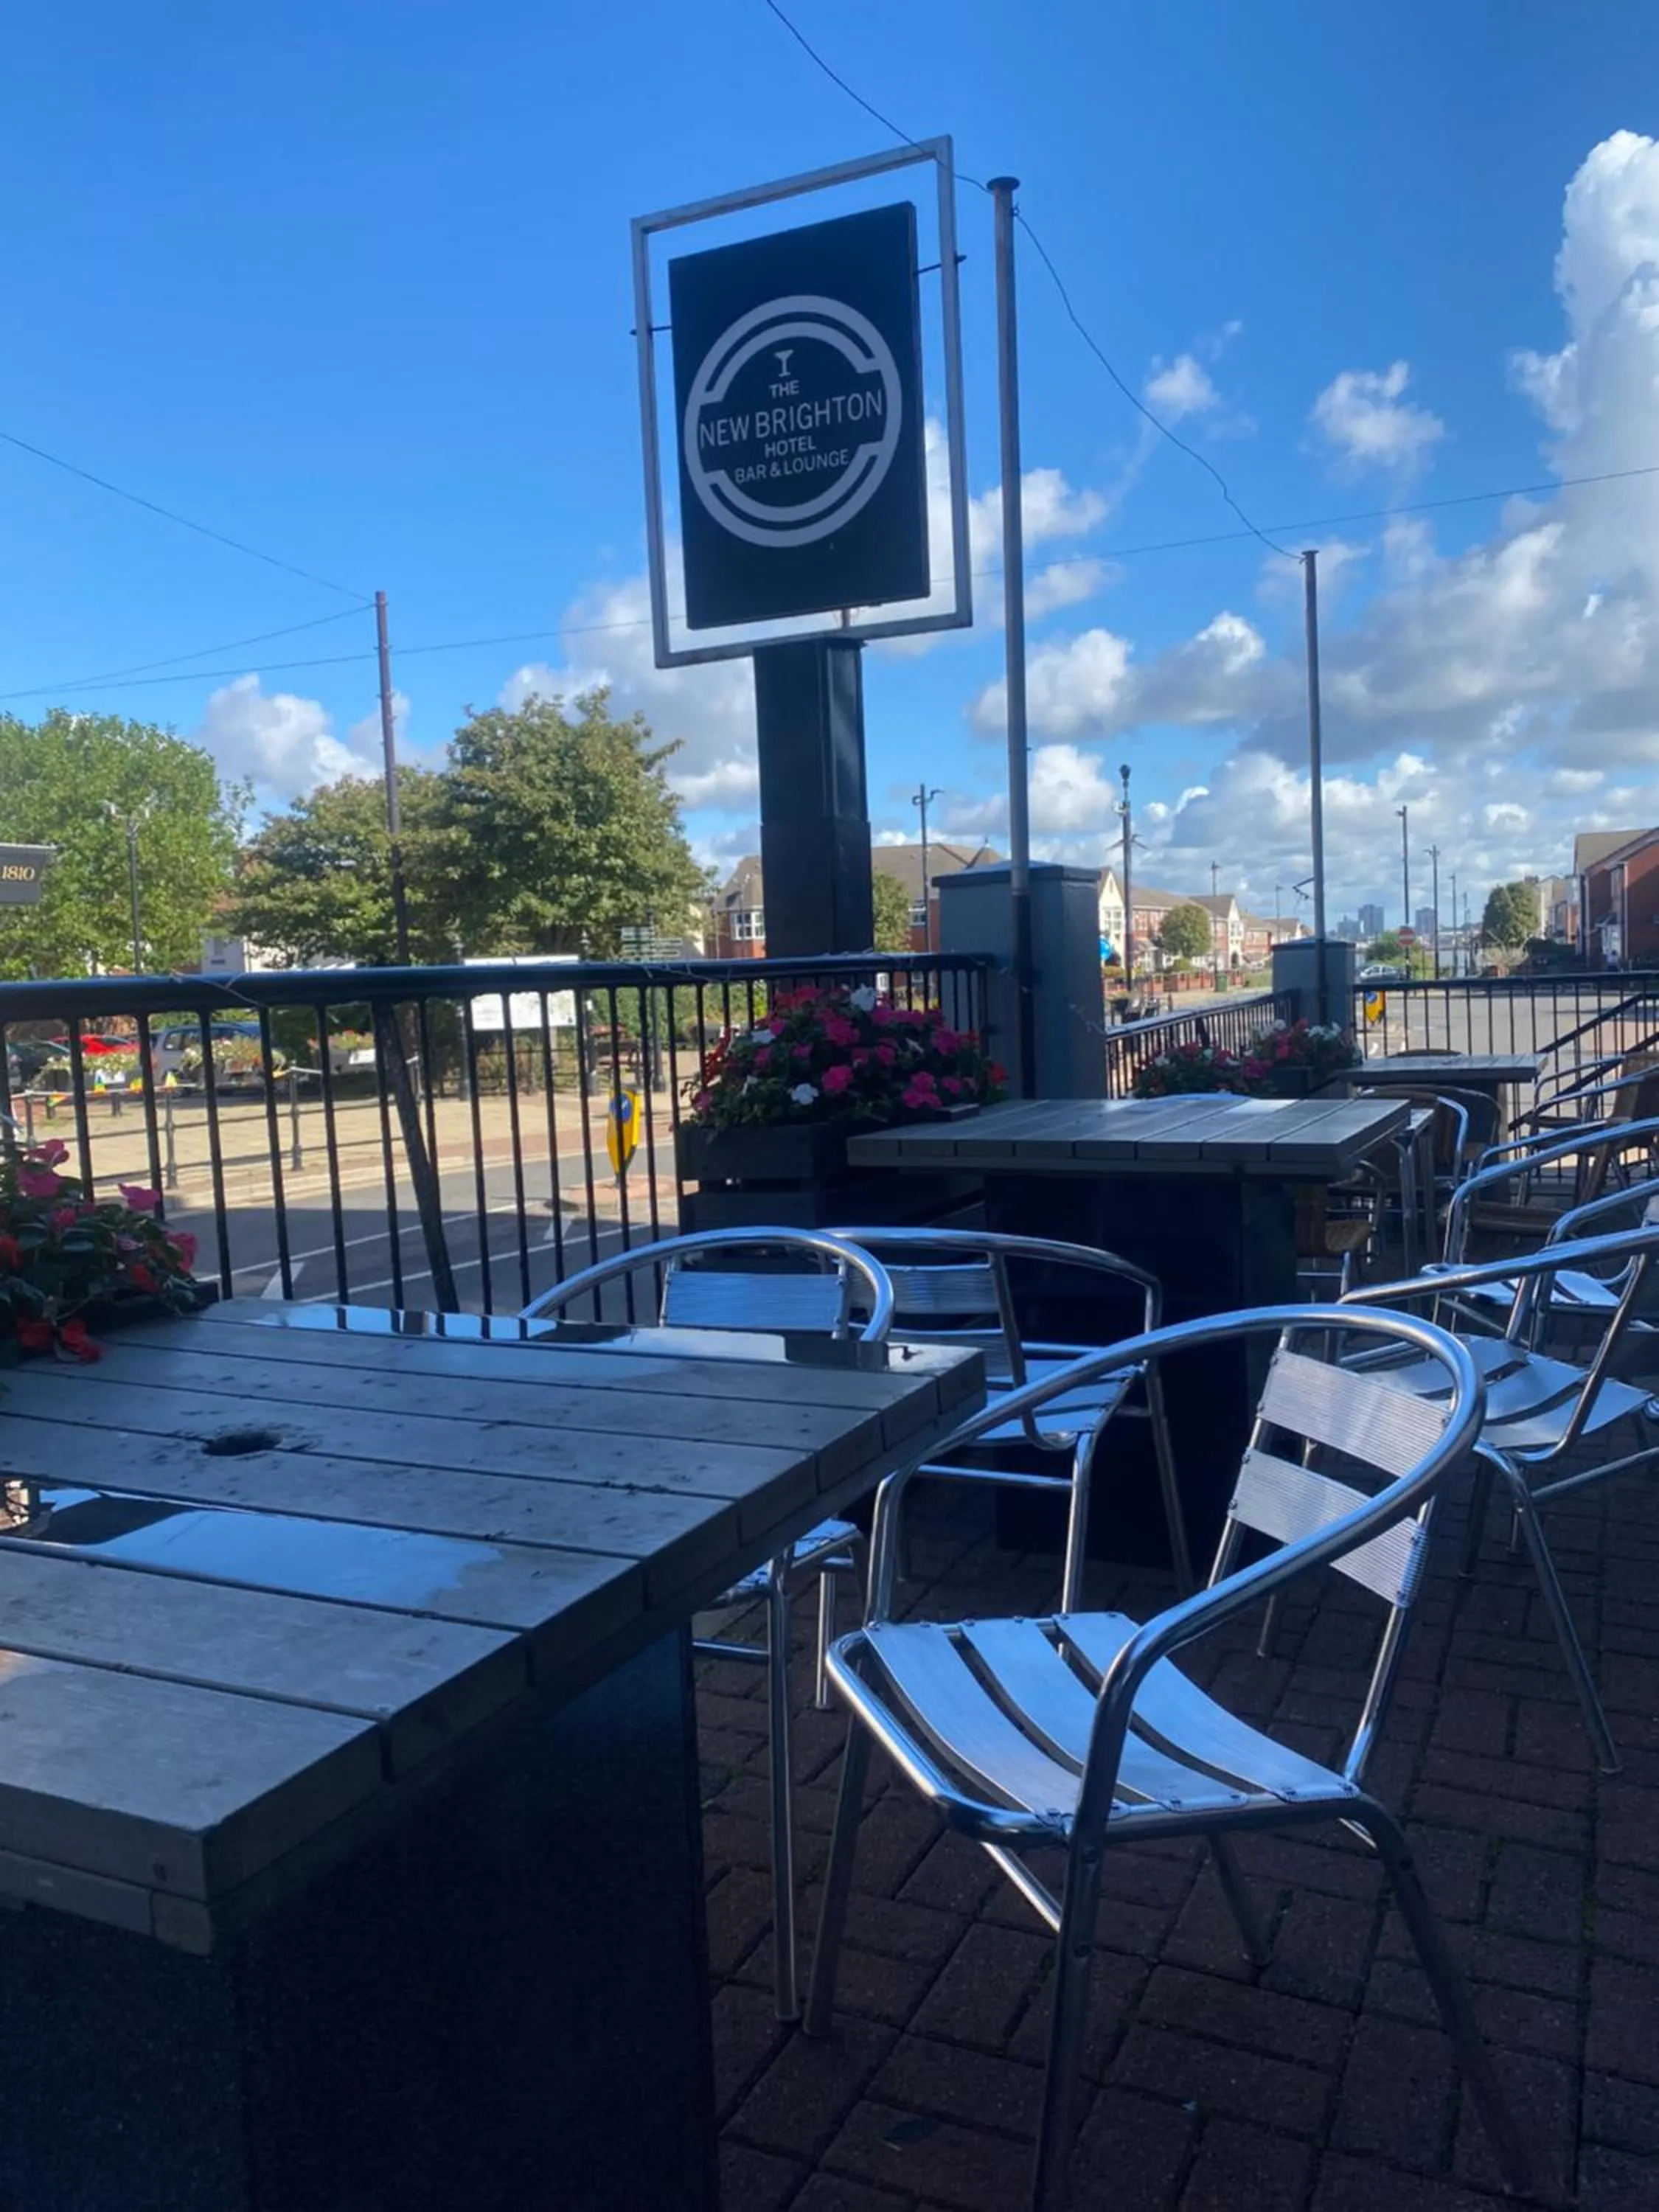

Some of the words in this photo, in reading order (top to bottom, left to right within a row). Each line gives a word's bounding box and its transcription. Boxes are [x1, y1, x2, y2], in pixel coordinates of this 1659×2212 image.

[768, 380, 800, 398] THE
[700, 415, 750, 448] NEW
[755, 389, 883, 438] BRIGHTON
[764, 436, 817, 459] HOTEL
[734, 465, 767, 484] BAR
[769, 462, 782, 478] &
[783, 448, 849, 475] LOUNGE
[2, 865, 35, 881] 1810
